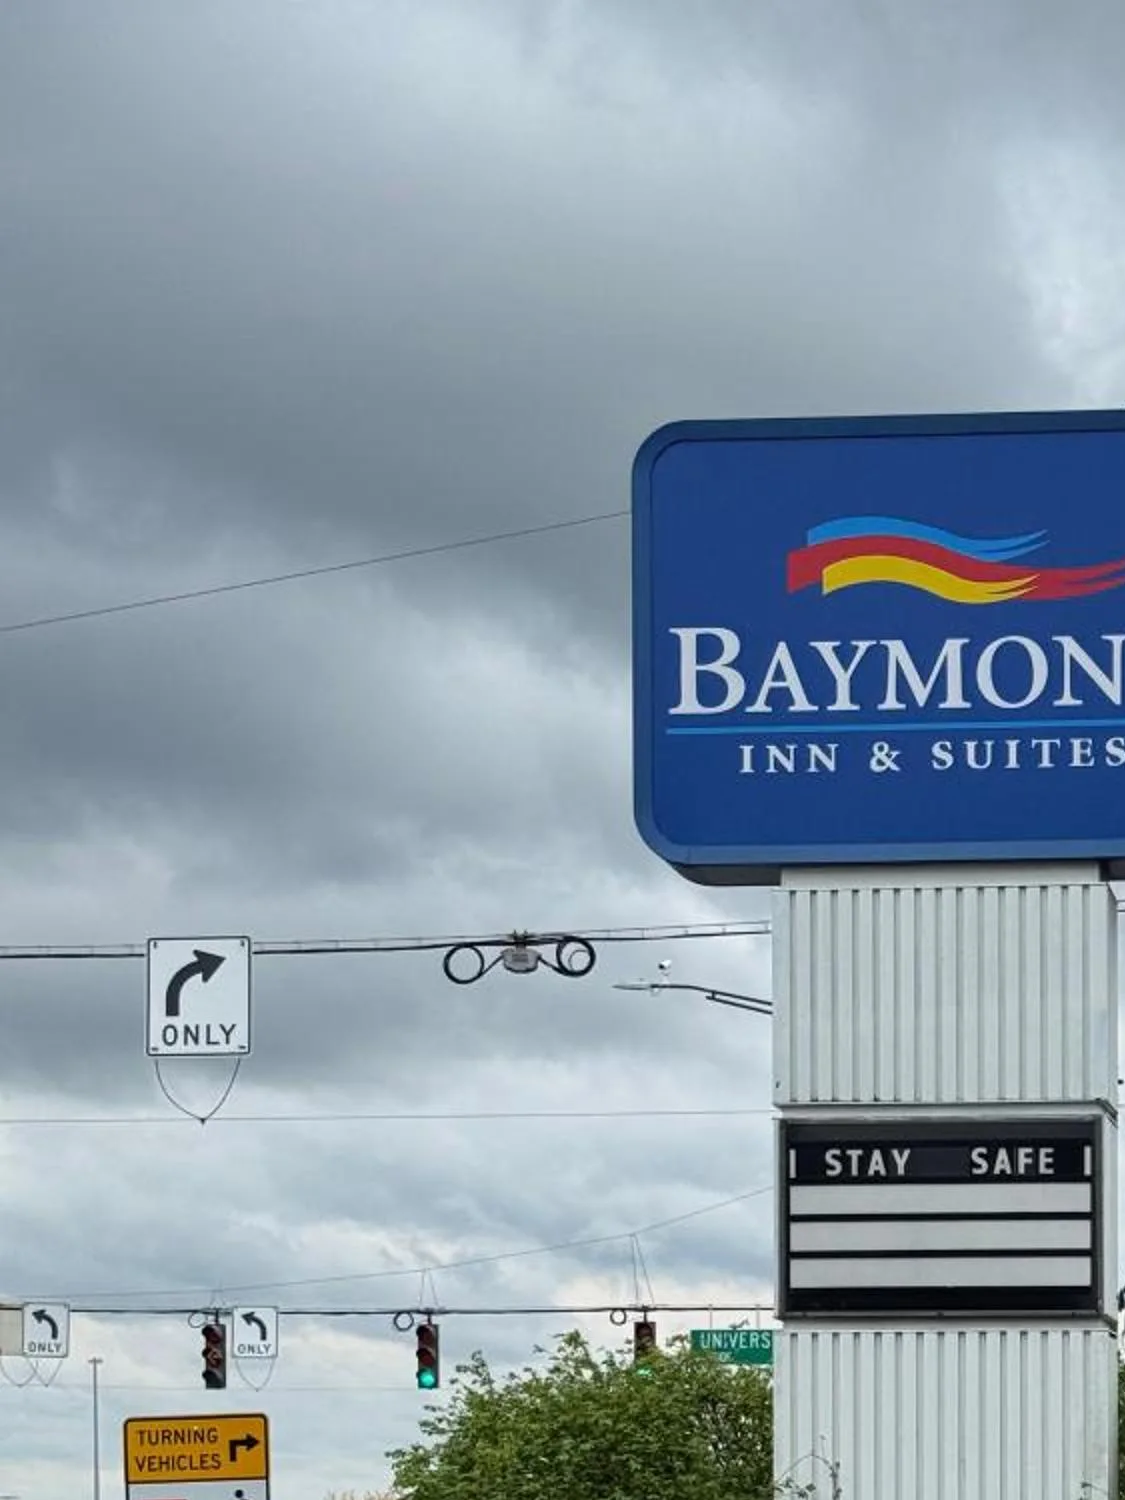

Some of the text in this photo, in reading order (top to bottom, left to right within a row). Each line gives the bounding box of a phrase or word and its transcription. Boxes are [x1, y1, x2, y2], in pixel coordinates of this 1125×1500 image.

[739, 744, 838, 773] INN
[870, 742, 900, 773] &
[162, 1023, 237, 1046] ONLY
[824, 1146, 1055, 1177] STAY SAFE
[28, 1341, 61, 1353] ONLY
[238, 1343, 271, 1355] ONLY
[138, 1427, 218, 1447] TURNING
[135, 1453, 221, 1472] VEHICLES
